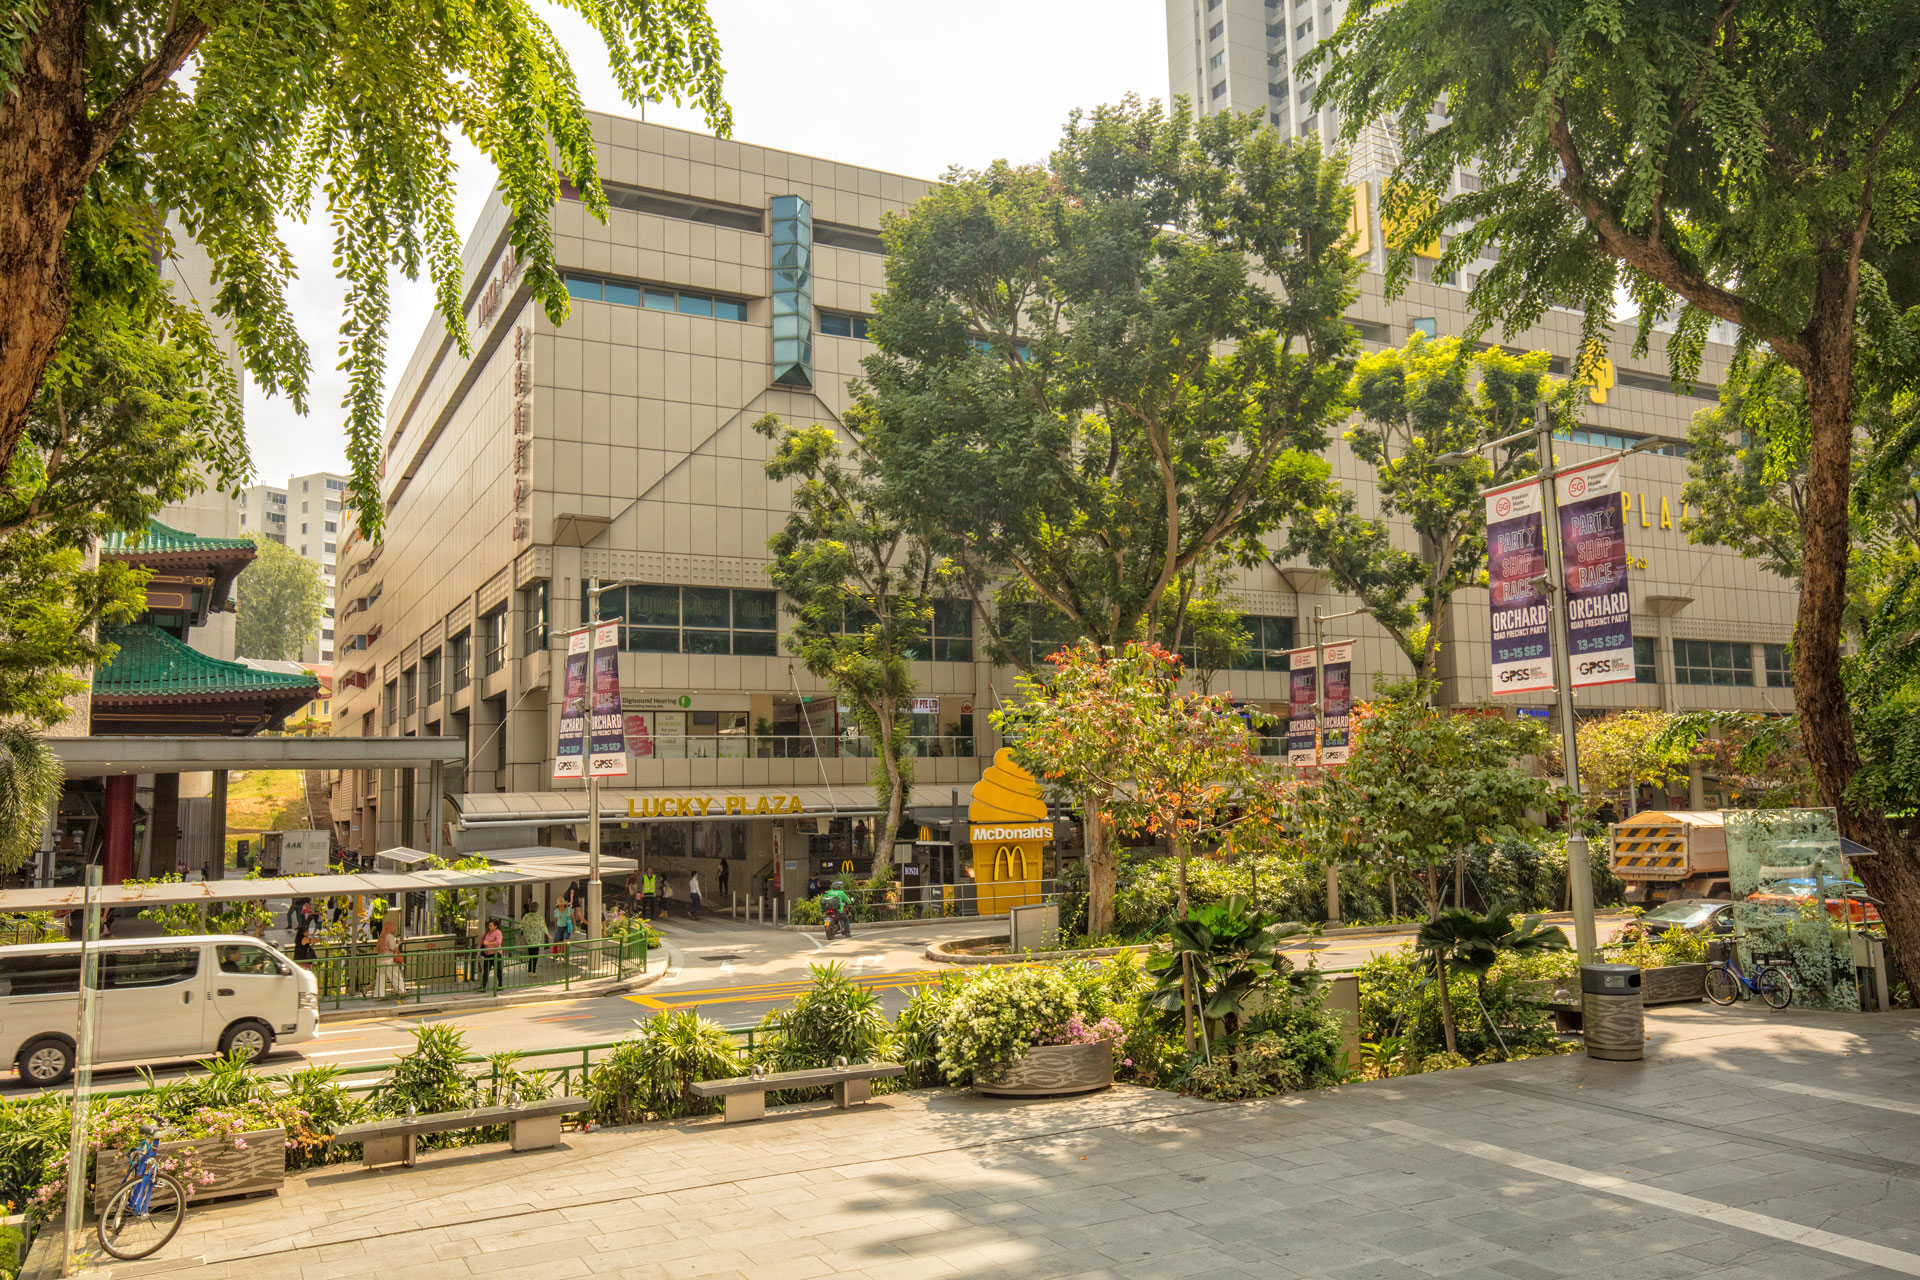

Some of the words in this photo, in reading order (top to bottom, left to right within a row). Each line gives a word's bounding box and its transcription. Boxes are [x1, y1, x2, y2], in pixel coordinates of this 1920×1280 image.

[1587, 472, 1606, 480] Passion
[1588, 484, 1608, 493] Possible
[1512, 493, 1529, 501] Passion
[1571, 507, 1614, 537] PARTY
[1498, 526, 1535, 554] PARTY
[1576, 537, 1612, 563] SHOP
[1502, 553, 1532, 578] SHOP
[1578, 563, 1614, 589] RACE
[1503, 579, 1532, 601] RACE
[1569, 592, 1628, 621] ORCHARD
[1492, 605, 1547, 632] ORCHARD
[1570, 619, 1584, 630] ROAD
[1584, 616, 1610, 628] PRECINCT
[1611, 614, 1629, 624] PARTY
[1493, 631, 1506, 641] ROAD
[1506, 628, 1529, 639] PRECINCT
[1529, 625, 1547, 636] PARTY
[1605, 634, 1626, 648] SEP
[1524, 644, 1544, 657] SEP
[1579, 660, 1611, 675] GPSS
[1500, 668, 1531, 683] GPSS
[622, 697, 653, 705] Digisound
[654, 697, 677, 705] Hearing
[920, 699, 929, 709] PTE
[929, 699, 938, 709] LTD
[560, 717, 584, 733] ORCHARD
[592, 714, 622, 731] ORCHARD
[1290, 719, 1315, 732] ORCHARD
[1324, 715, 1349, 728] ORCHARD
[608, 742, 621, 751] SEP
[593, 759, 613, 769] GPSS
[627, 797, 713, 818] LUCKY
[725, 795, 805, 816] PLAZA
[973, 826, 1053, 841] McDonald's
[285, 841, 302, 849] AAK
